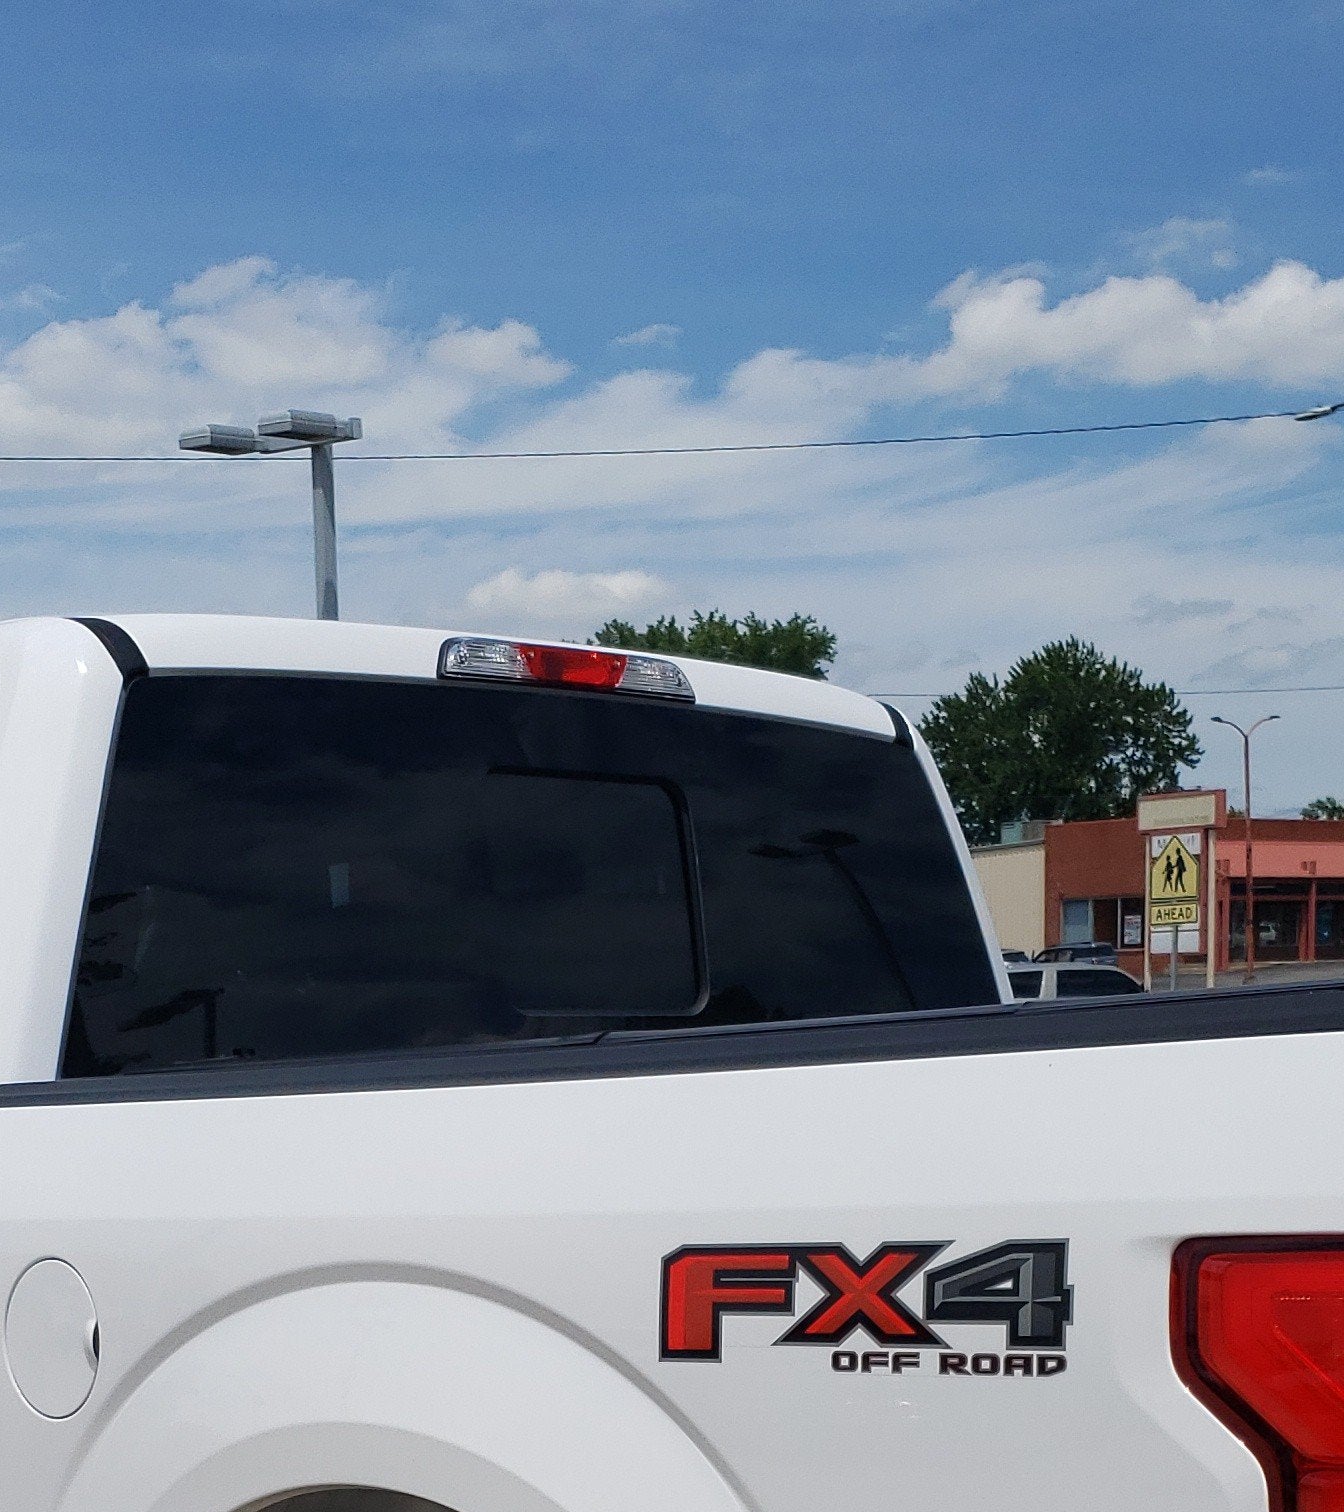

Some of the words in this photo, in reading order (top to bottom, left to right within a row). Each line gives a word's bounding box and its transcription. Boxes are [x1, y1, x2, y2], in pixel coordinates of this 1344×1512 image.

[1156, 905, 1193, 921] AHEAD
[659, 1238, 1074, 1363] FX4
[831, 1350, 920, 1374] OFF
[938, 1352, 1068, 1378] ROAD
